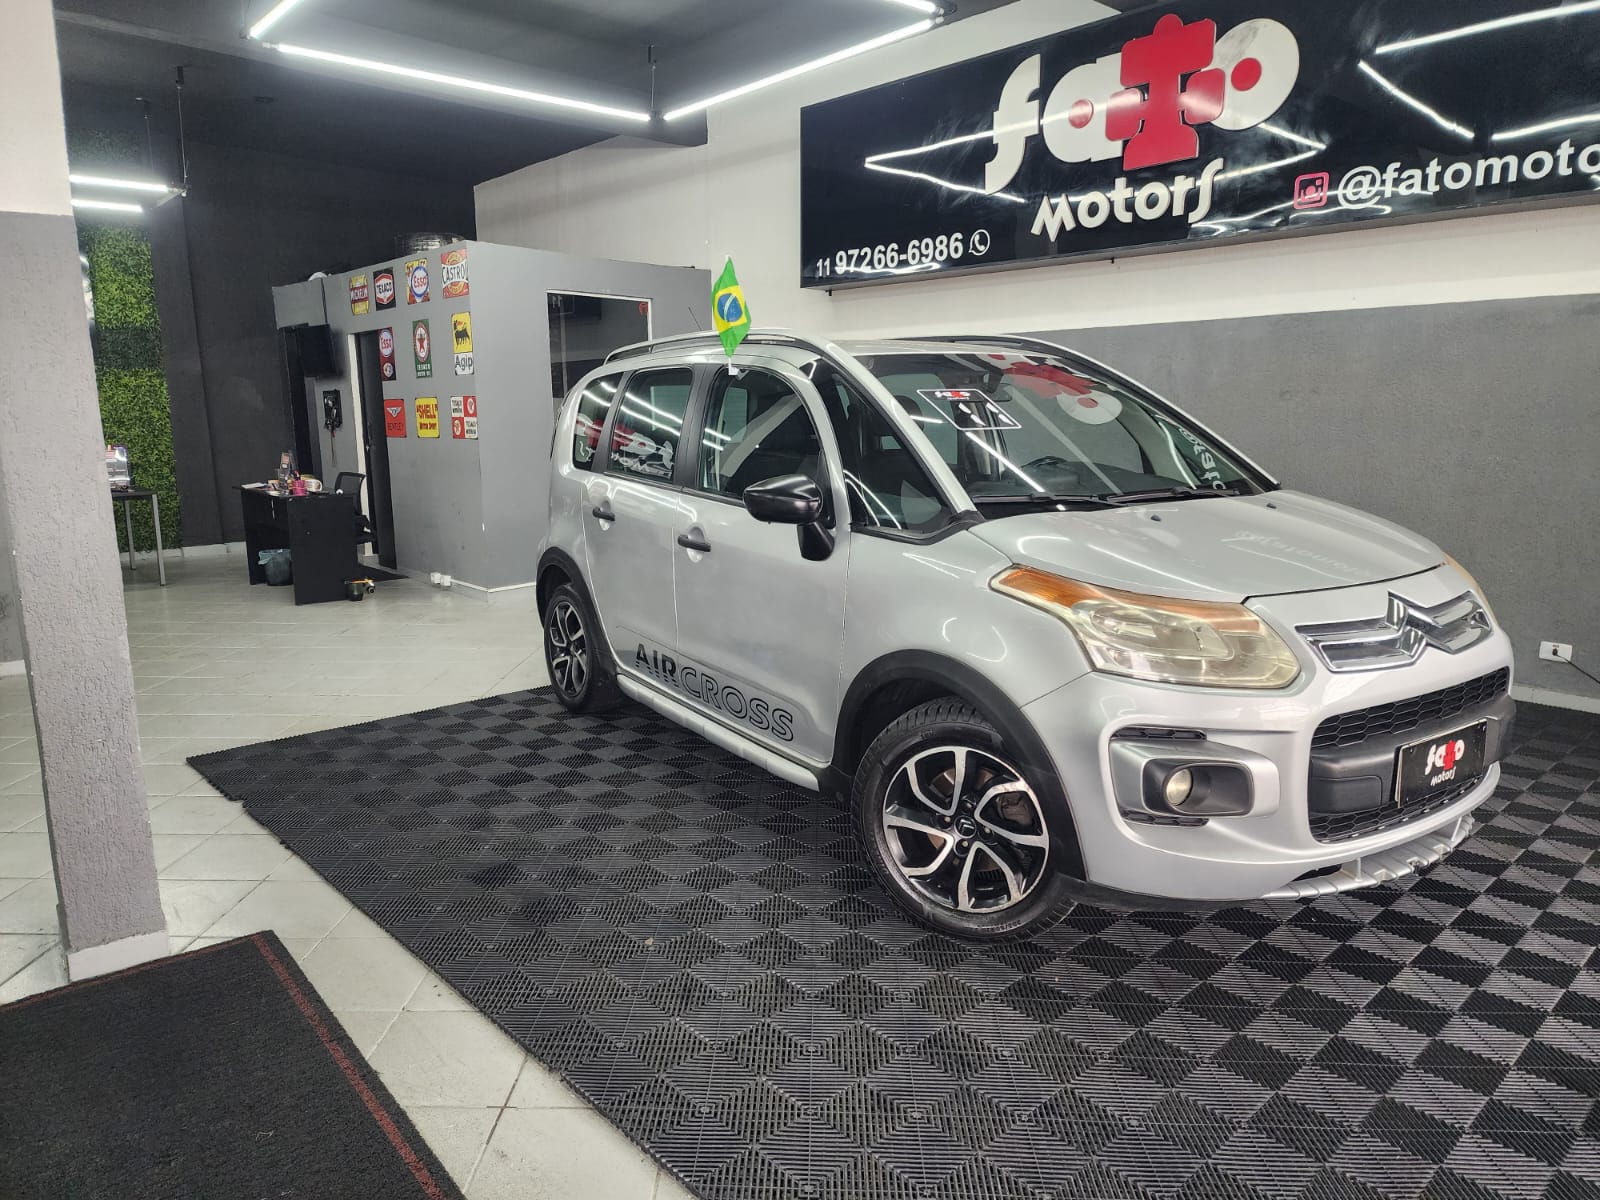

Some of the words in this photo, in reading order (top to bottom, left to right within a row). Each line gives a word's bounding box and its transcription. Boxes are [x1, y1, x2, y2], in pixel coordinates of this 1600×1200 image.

[816, 257, 831, 278] 11
[835, 232, 964, 275] 97266-6986
[455, 356, 473, 371] Agip
[635, 643, 794, 742] AIRCROSS
